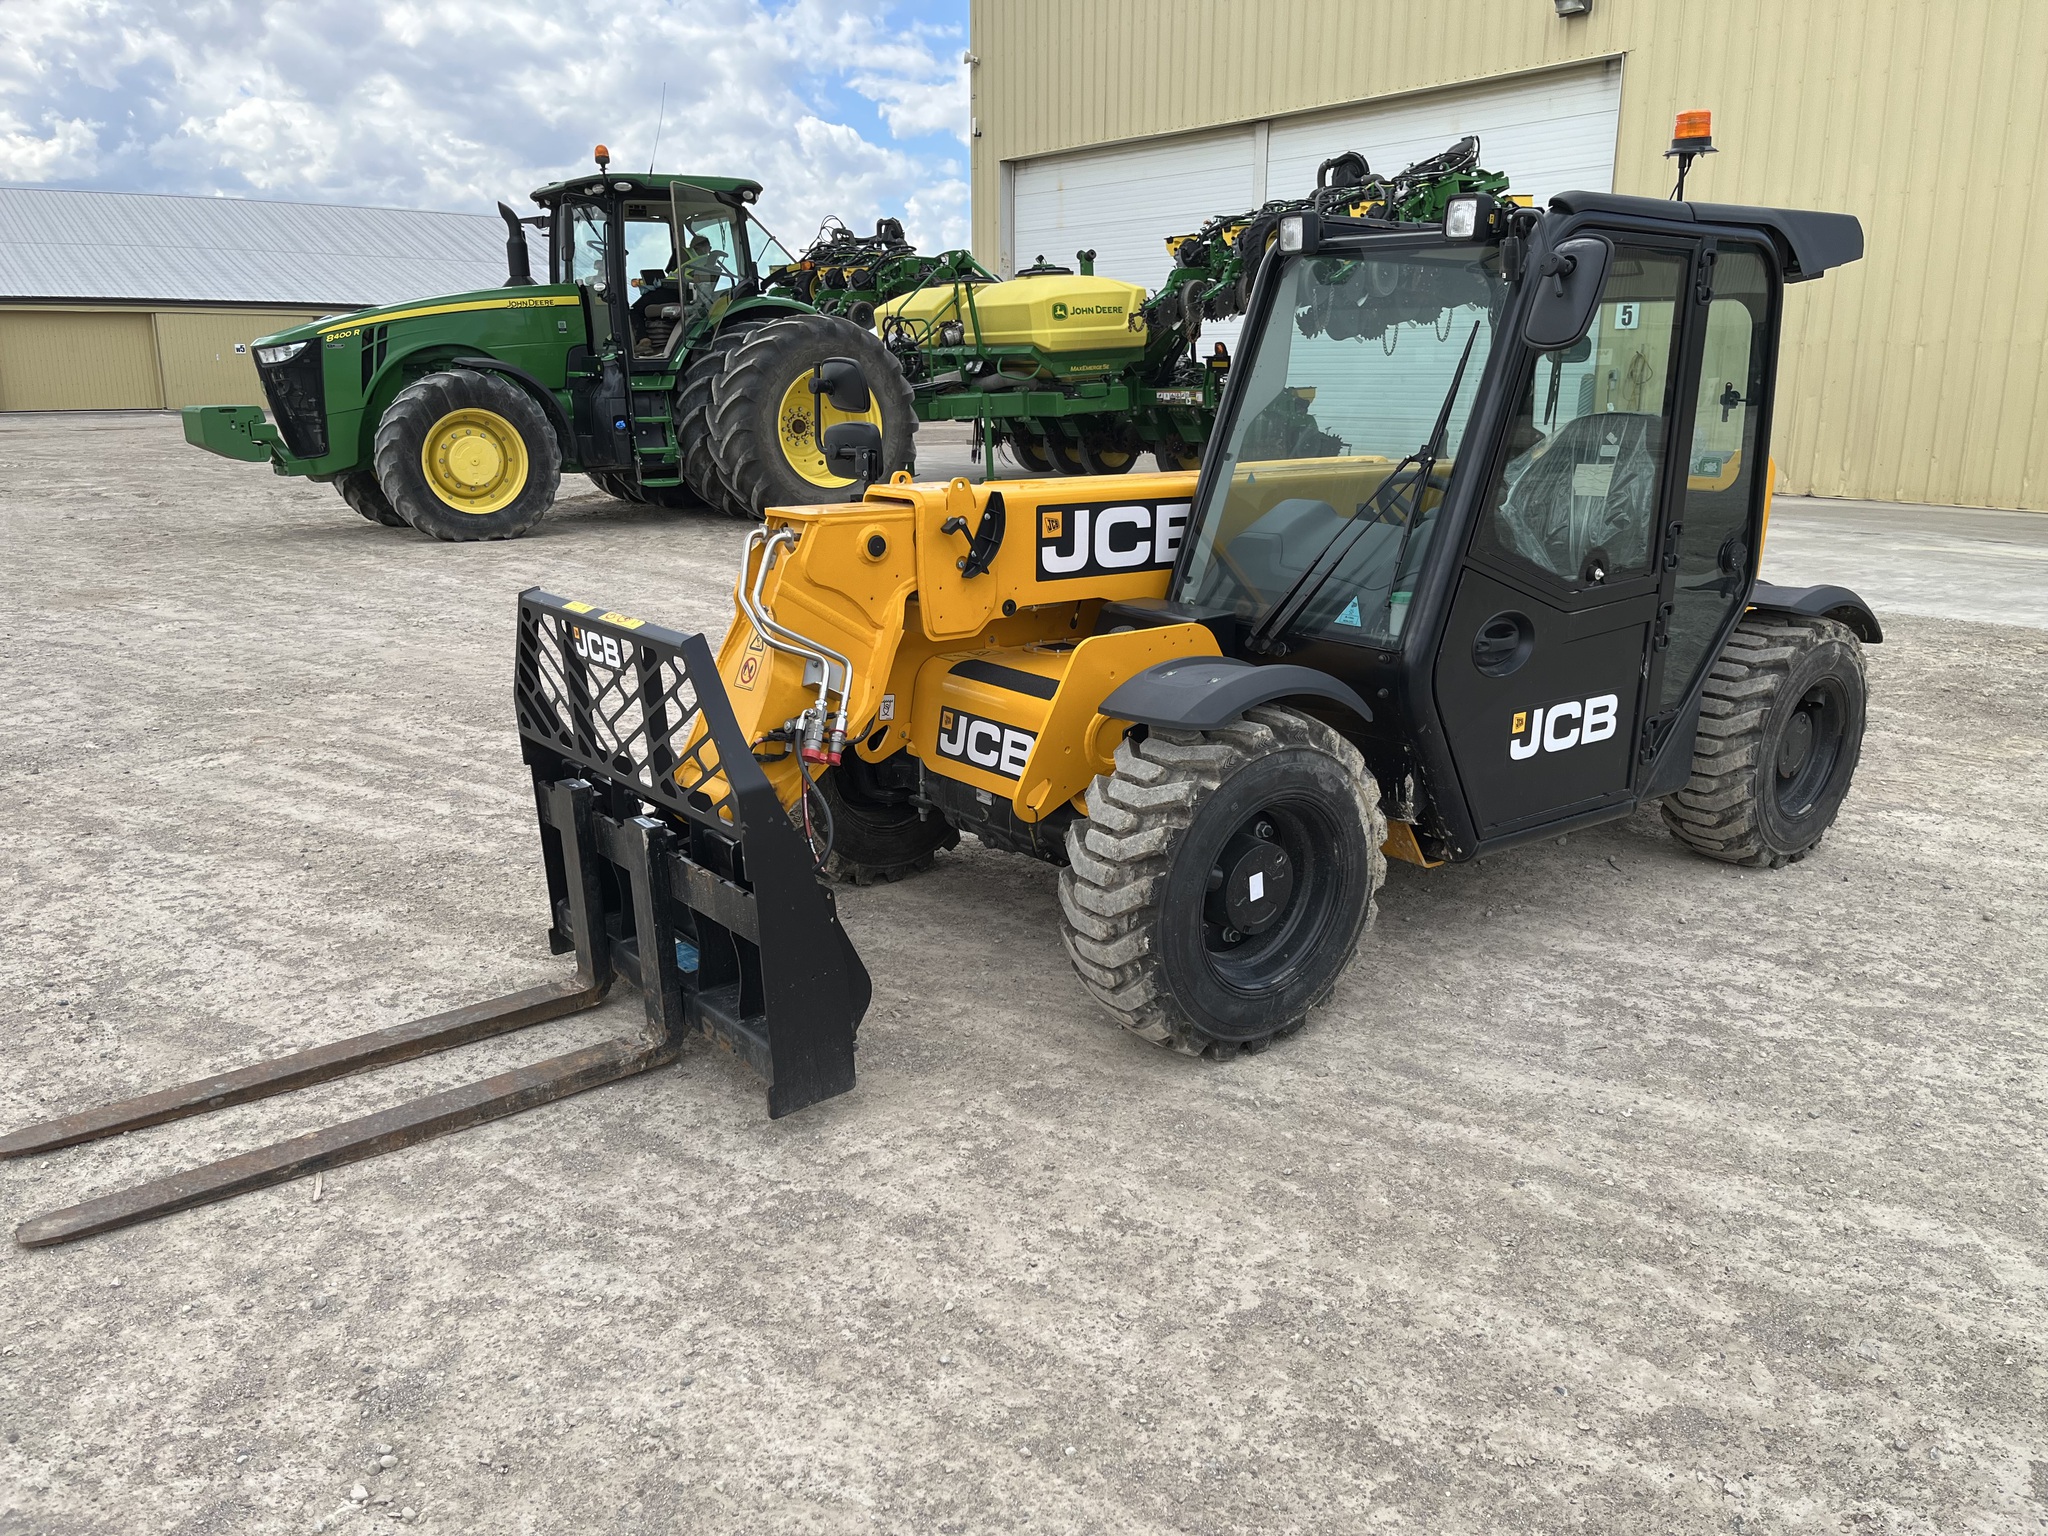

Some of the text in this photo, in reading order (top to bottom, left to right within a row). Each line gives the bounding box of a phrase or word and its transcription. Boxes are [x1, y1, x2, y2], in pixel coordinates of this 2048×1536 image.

[507, 300, 527, 308] JOHN
[1070, 305, 1123, 315] JOHN DEERE
[1621, 305, 1633, 326] 5
[326, 328, 361, 343] 8400 R
[576, 629, 621, 668] JCB
[1510, 694, 1618, 760] JCB
[940, 715, 1036, 776] JCB
